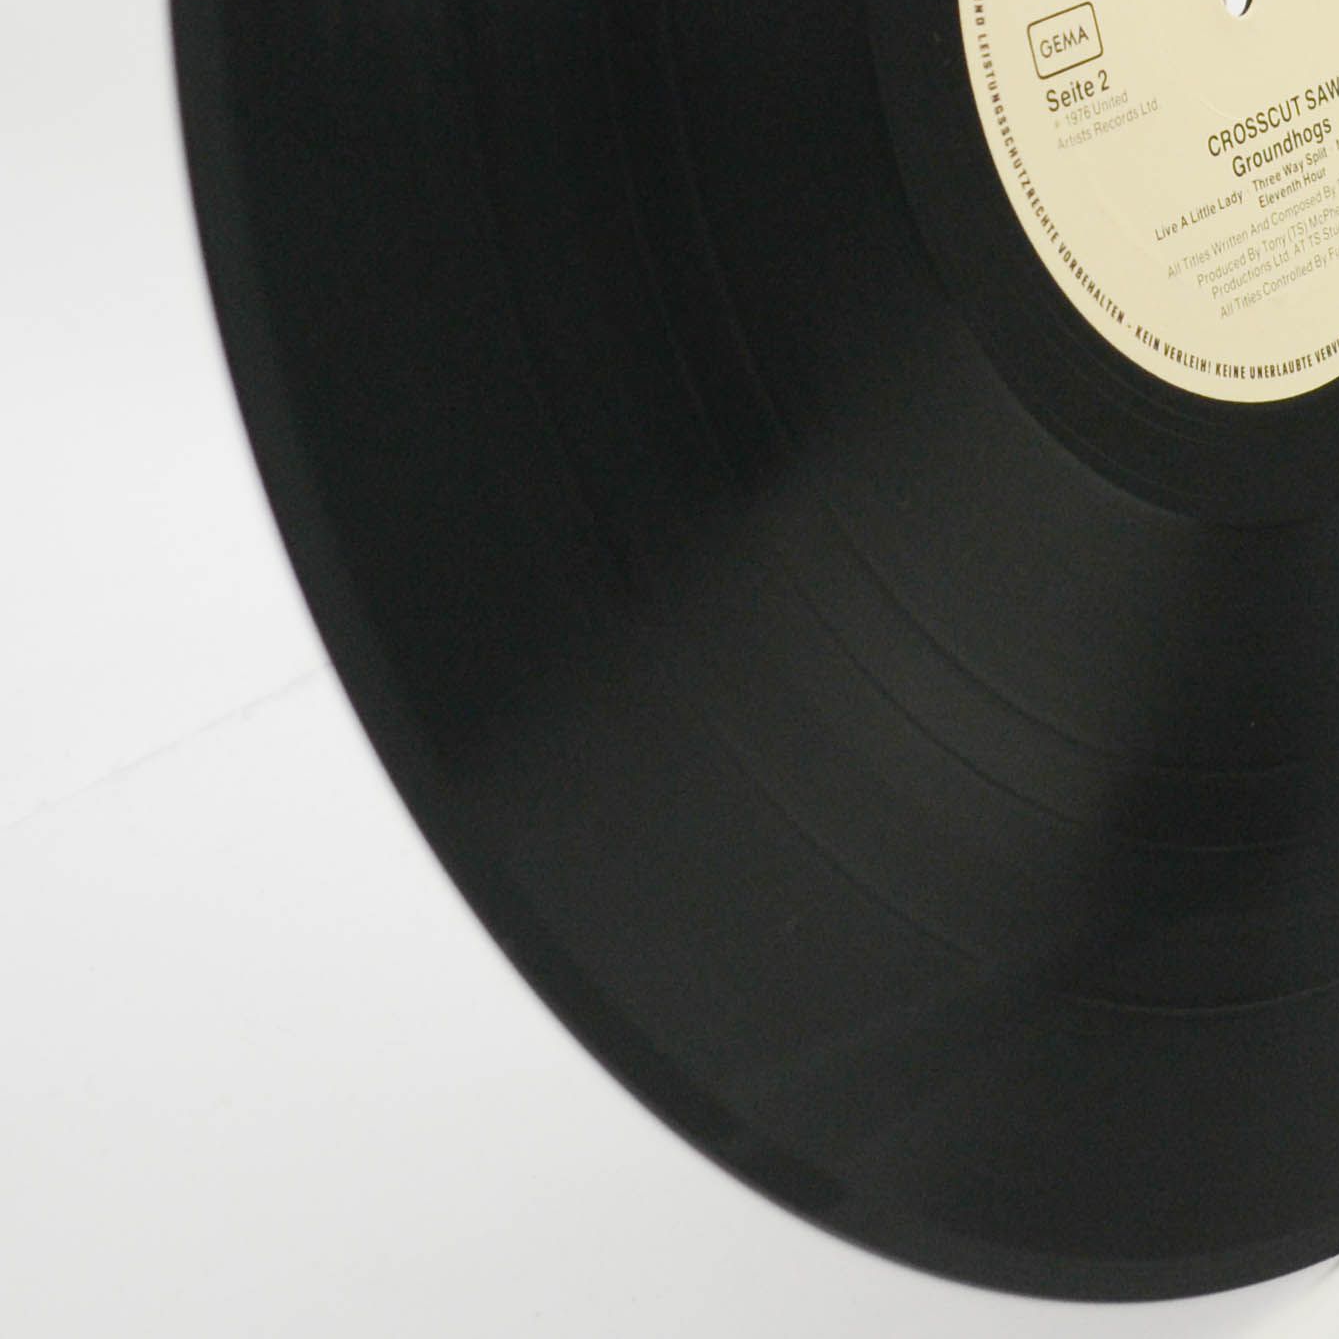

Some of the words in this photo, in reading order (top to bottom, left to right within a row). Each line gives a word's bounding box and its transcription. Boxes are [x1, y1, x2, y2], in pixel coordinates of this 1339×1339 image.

[1039, 26, 1089, 58] GEMA
[1046, 80, 1095, 112] Seite
[1098, 69, 1110, 92] 2
[1092, 88, 1129, 115] United
[1057, 128, 1093, 150] Artists
[1094, 109, 1140, 137] Records
[1208, 95, 1301, 157] CROSSCUT
[1232, 118, 1332, 177] Groundhogs
[978, 33, 1059, 244] LEISTUNGSSCHUTZRECHTE
[1058, 241, 1125, 325] VORBEHALTEN
[1135, 325, 1160, 351] KEIN
[1163, 342, 1211, 374] VERLEIH!
[1215, 363, 1246, 380] KEINE
[1249, 353, 1313, 380] UNERLAUBTE
[1155, 222, 1178, 241] Live
[1181, 215, 1189, 229] A
[1190, 204, 1217, 224] Little
[1217, 190, 1244, 210] Lady
[1252, 171, 1282, 193] Three
[1282, 160, 1305, 177] Way
[1305, 146, 1328, 167] Split
[1258, 177, 1302, 209] Eleventh
[1302, 167, 1327, 187] Hour
[1168, 262, 1181, 279] All
[1183, 248, 1210, 270] Titles
[1211, 229, 1249, 257] Written
[1250, 216, 1270, 237] And
[1270, 190, 1322, 226] Composed
[1323, 184, 1336, 201] By
[1197, 253, 1247, 286] Produced
[1247, 246, 1260, 263] By
[1262, 236, 1286, 253] Tony
[1287, 221, 1308, 242] (TS)
[1211, 261, 1273, 300] Productions
[1294, 239, 1306, 257] AT
[1308, 231, 1321, 247] TS
[1220, 302, 1234, 320] All
[1234, 288, 1262, 310] Titles
[1262, 259, 1313, 296] Controlled
[1314, 253, 1327, 269] By
